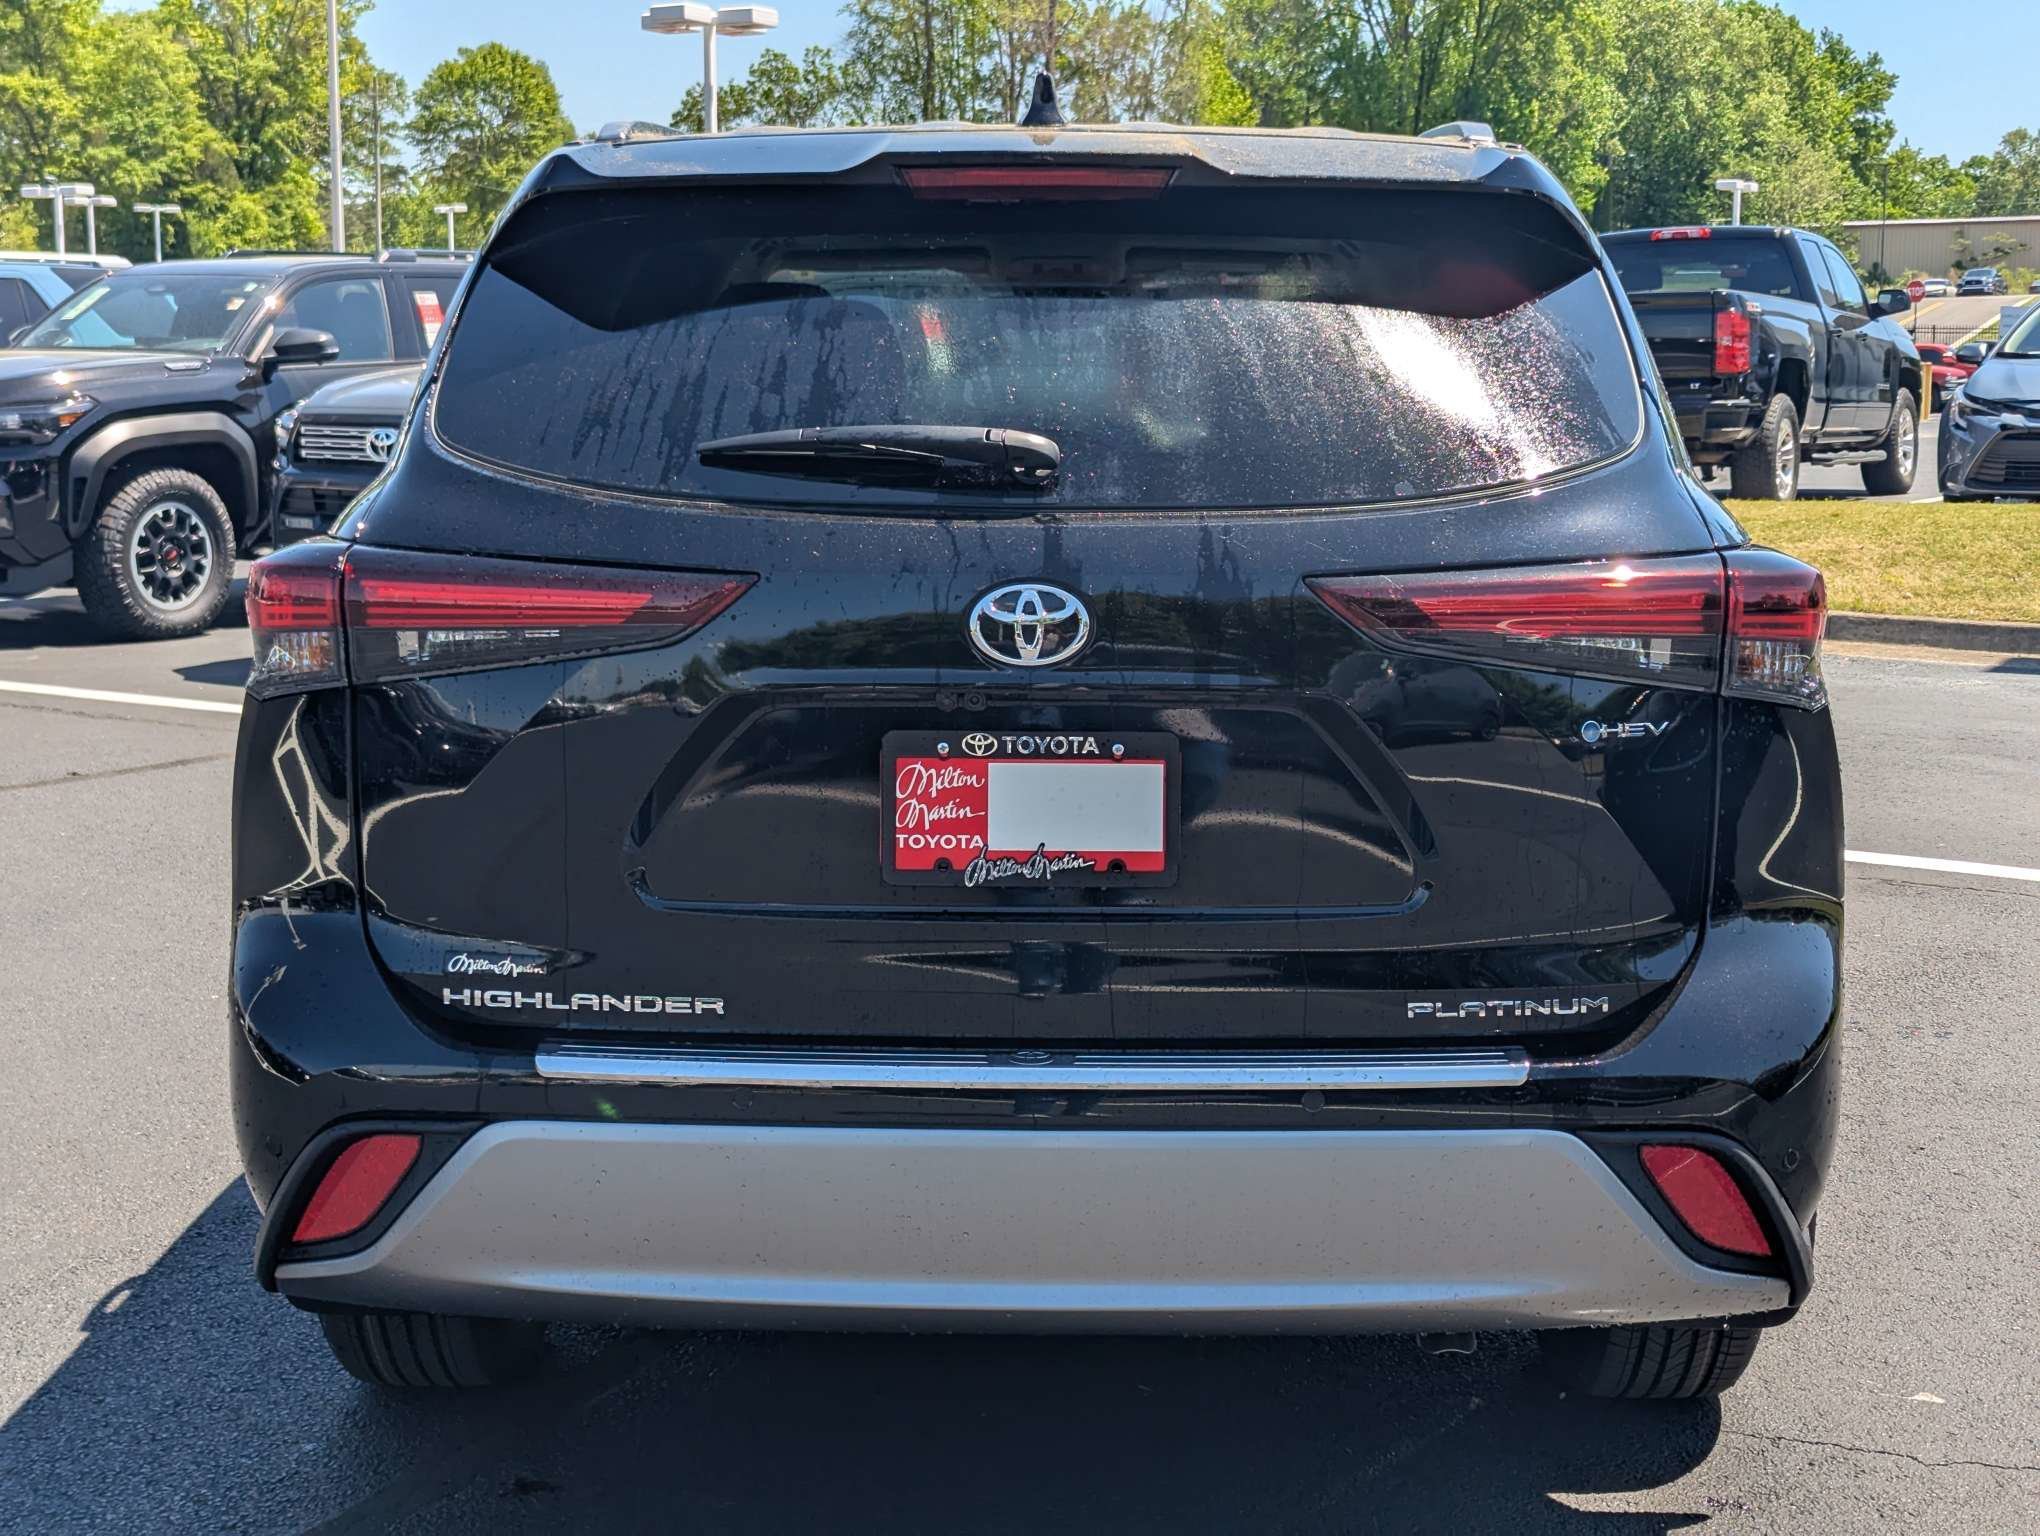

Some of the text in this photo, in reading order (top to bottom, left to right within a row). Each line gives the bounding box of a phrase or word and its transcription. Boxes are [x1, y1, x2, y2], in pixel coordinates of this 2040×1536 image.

[1908, 287, 1925, 296] STOP
[1001, 735, 1100, 755] TOYOTA
[896, 761, 985, 799] Milton
[896, 797, 985, 830] Martin
[896, 834, 985, 850] TOYOTA
[964, 843, 1095, 888] Milton Martin
[447, 952, 547, 978] Milton Martin
[442, 987, 725, 1015] HIGHLANDER
[1407, 996, 1609, 1018] PLATINUM
